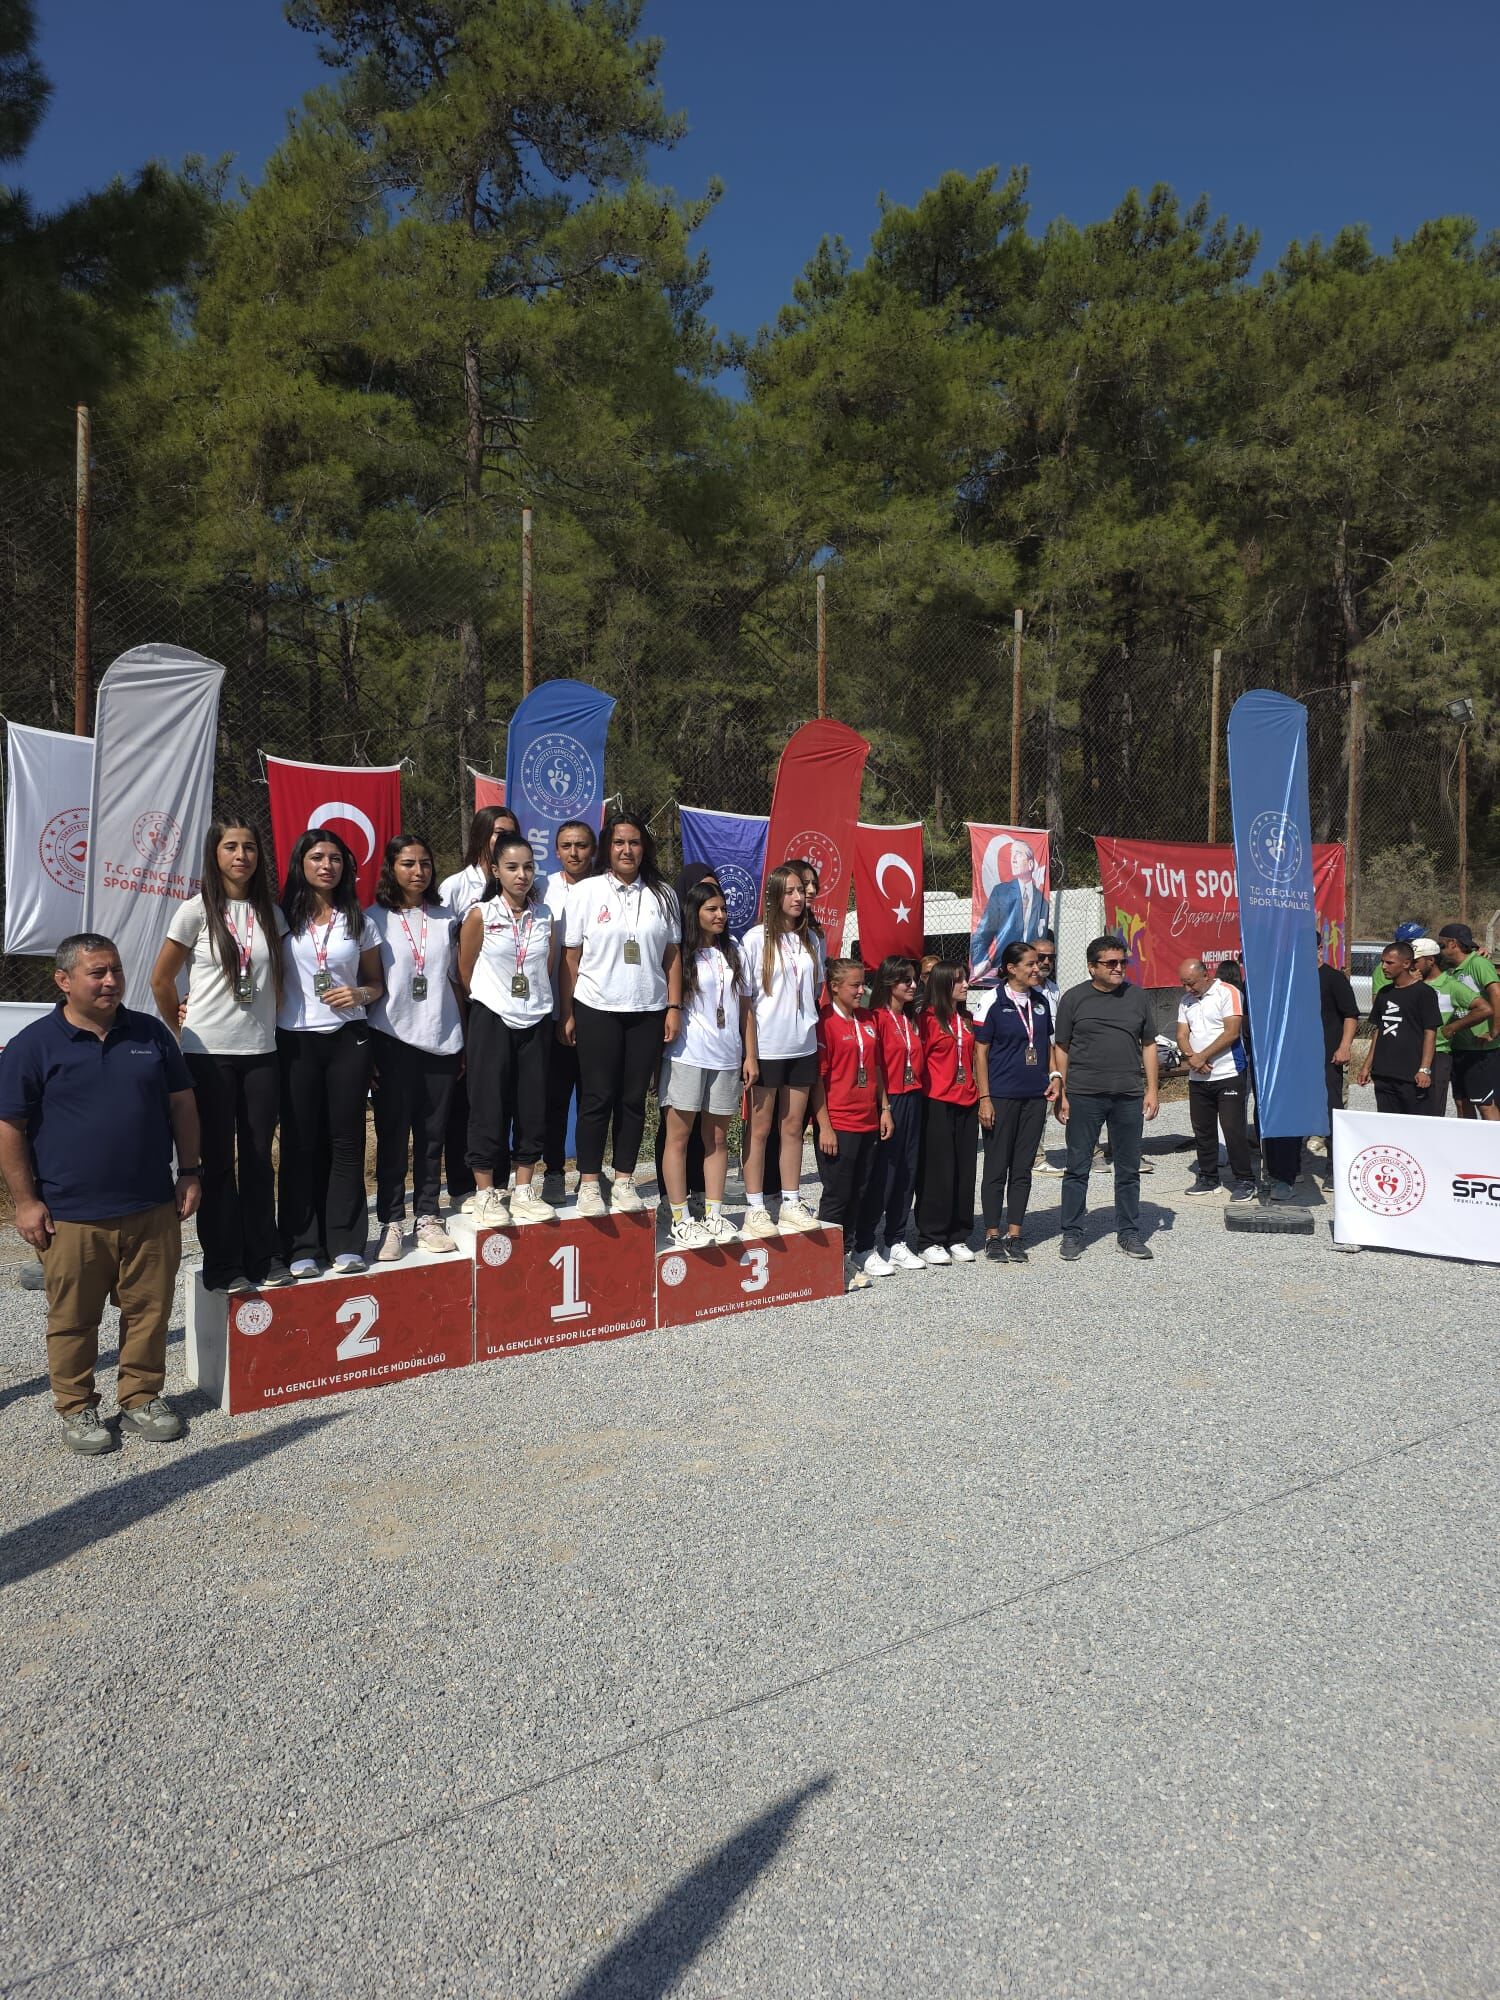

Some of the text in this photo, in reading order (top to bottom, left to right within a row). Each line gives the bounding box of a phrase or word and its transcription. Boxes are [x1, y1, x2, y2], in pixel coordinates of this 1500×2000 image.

[103, 877, 138, 891] SPOR
[104, 862, 128, 876] T.C.
[132, 867, 185, 886] GENÇLİK
[1141, 862, 1188, 898] TÜM
[827, 907, 838, 917] VE
[1202, 950, 1233, 962] MEHMET
[549, 1244, 591, 1322] 1
[739, 1247, 770, 1293] 3
[695, 1288, 812, 1317] ULA GENÇLİK VE SPOR İLÇE MÜDÜRLÜĞÜ
[335, 1294, 380, 1362] 2
[487, 1318, 647, 1354] ULA GENÇLİK VE SPOR İLÇE MÜDÜRLÜĞÜ
[263, 1352, 446, 1398] ULA GENÇLİK VE SPOR İLÇE MÜDÜRLÜĞÜ
